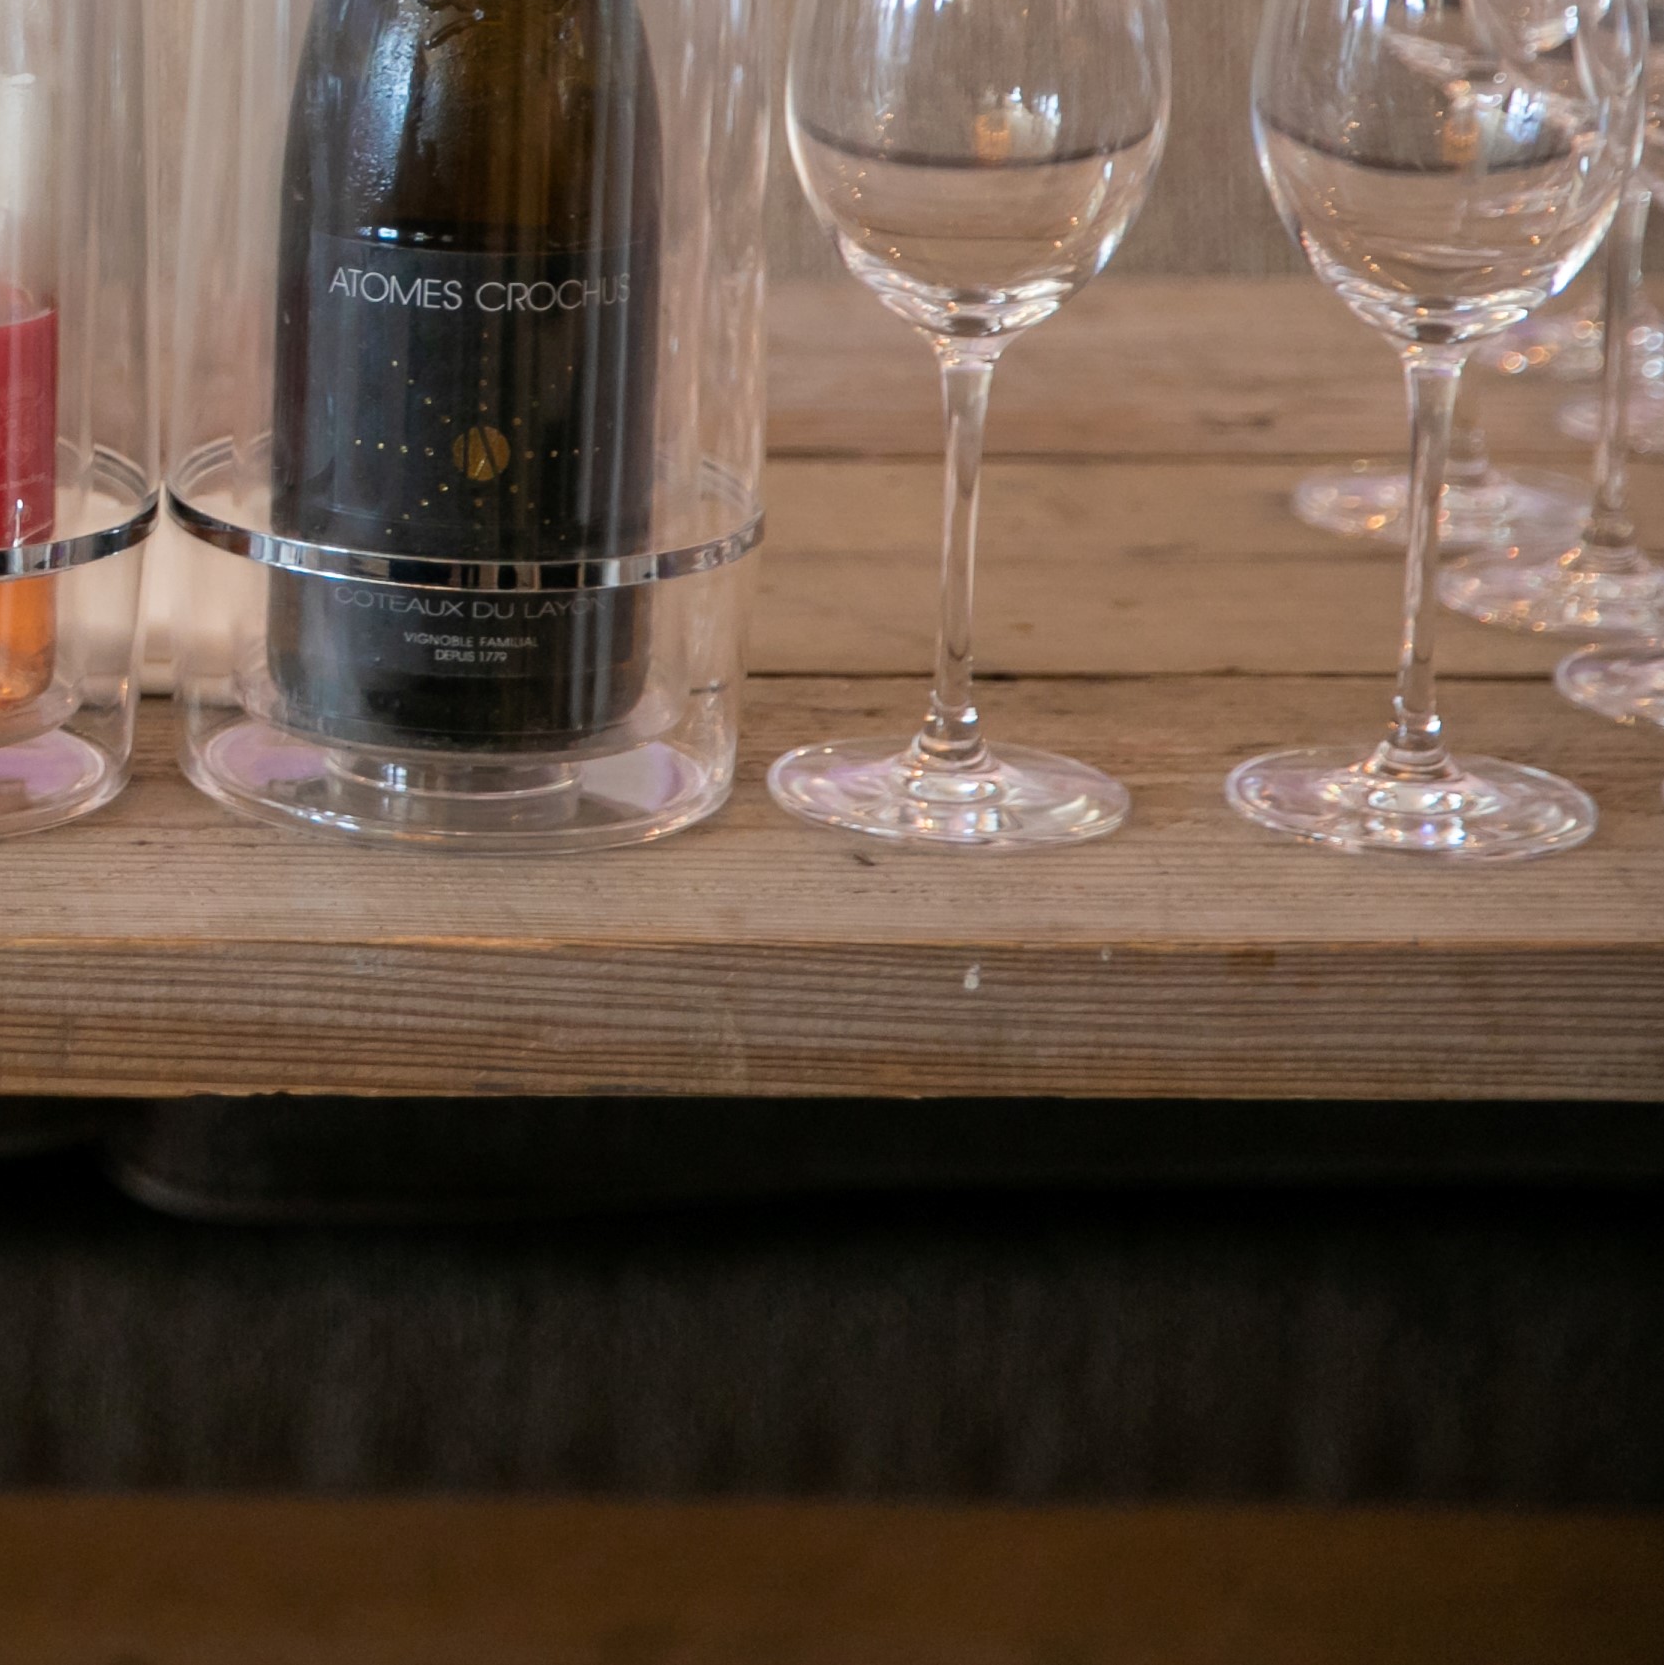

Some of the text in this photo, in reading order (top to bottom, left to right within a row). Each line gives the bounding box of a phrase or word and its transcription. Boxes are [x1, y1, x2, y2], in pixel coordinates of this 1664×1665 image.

[328, 266, 631, 312] ATOMES CROCHUS
[334, 585, 464, 617] COTEAUX
[472, 601, 515, 619] DU
[404, 631, 539, 648] VIGNOBLE FAMILIAL
[434, 648, 475, 663] DEPUIS
